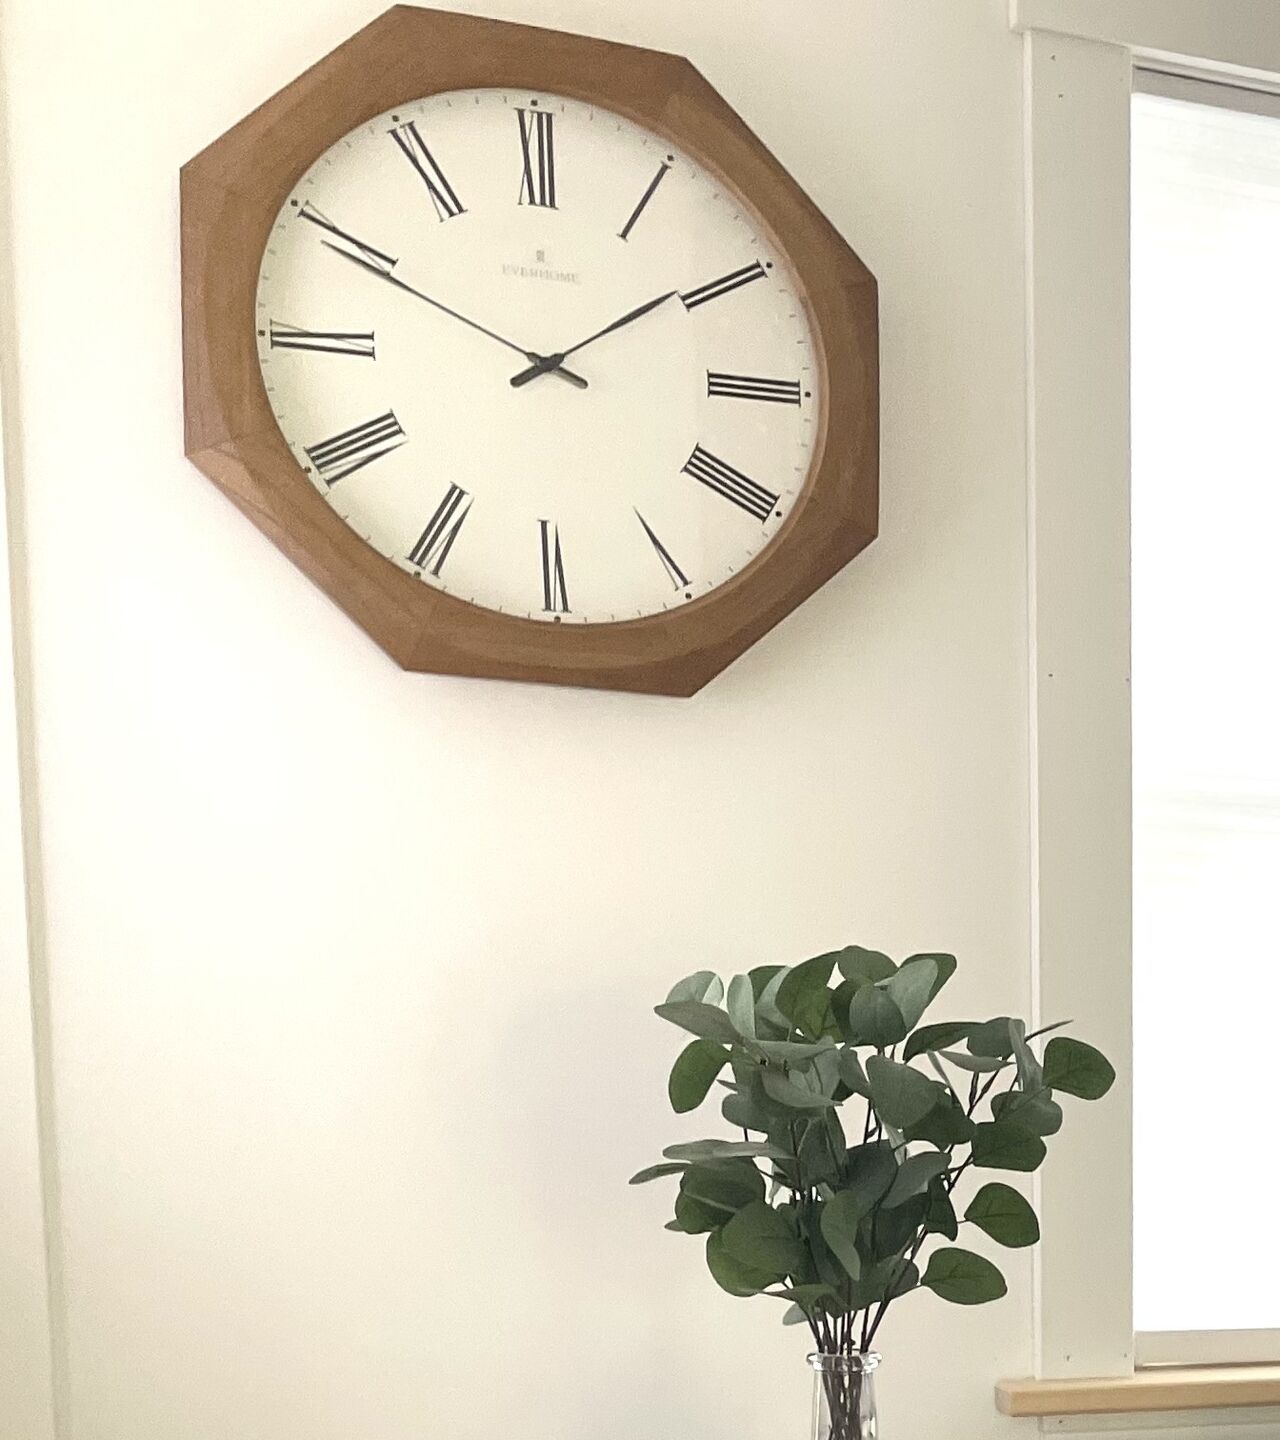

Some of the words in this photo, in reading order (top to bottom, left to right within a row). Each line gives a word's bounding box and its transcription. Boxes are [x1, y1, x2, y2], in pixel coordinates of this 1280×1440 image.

[388, 121, 468, 223] XI
[514, 107, 558, 210] XII
[297, 199, 398, 274] X
[618, 162, 673, 240] I
[678, 259, 770, 312] II
[270, 318, 376, 361] IX
[706, 369, 802, 408] III
[304, 408, 408, 488] VIII
[681, 442, 782, 523] IIII
[407, 481, 474, 577] VII
[538, 518, 572, 612] VI
[634, 506, 692, 591] V
